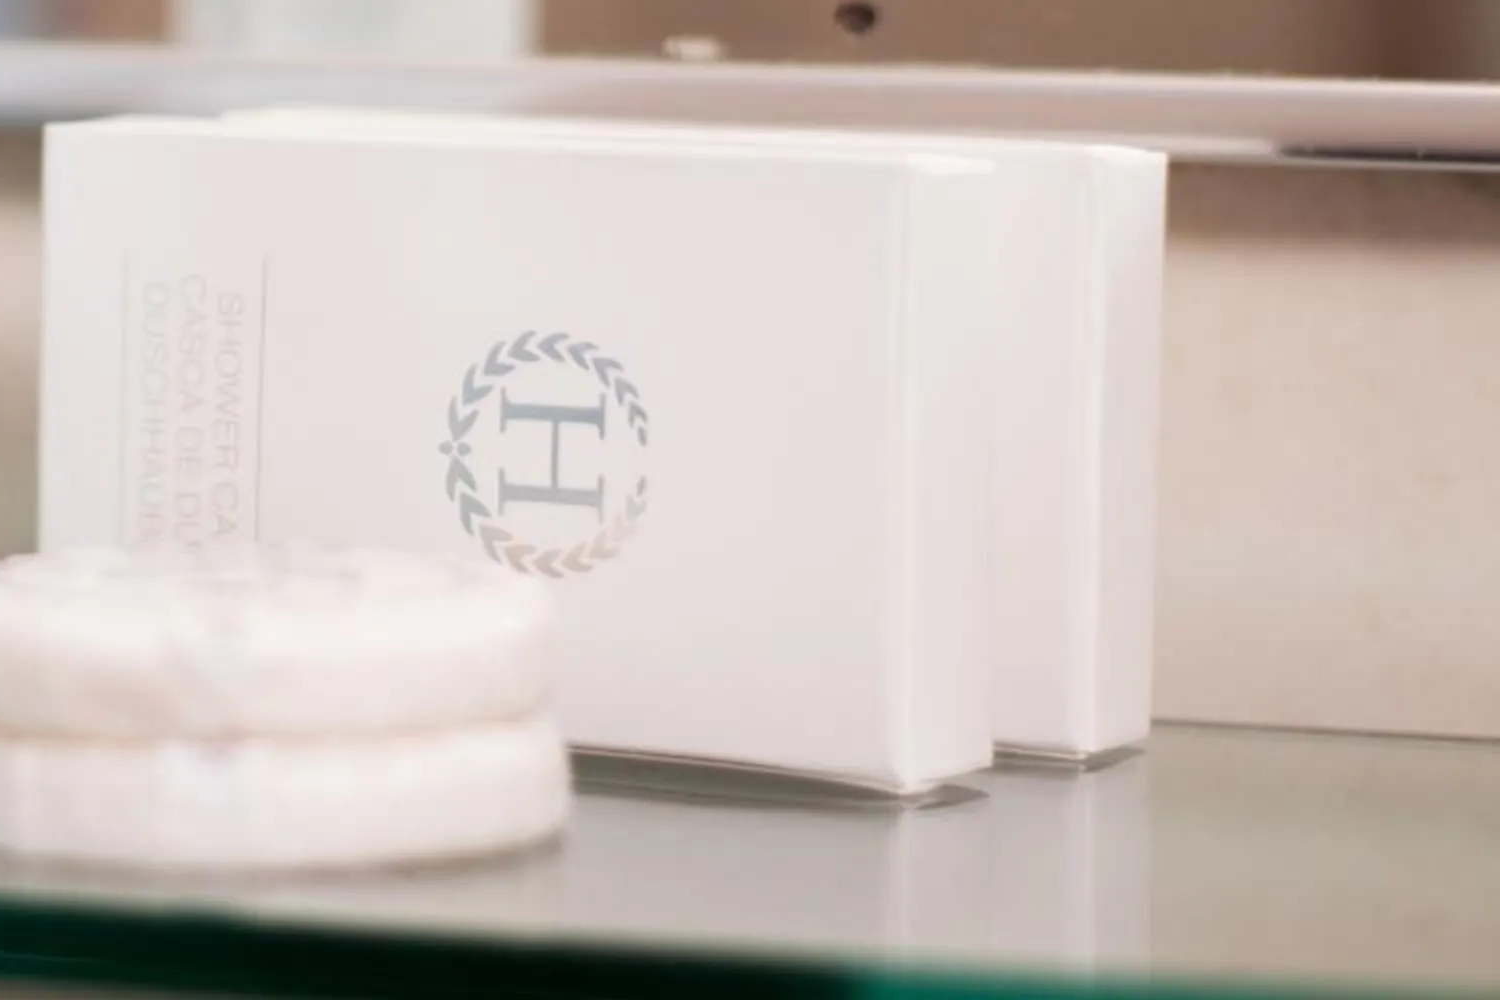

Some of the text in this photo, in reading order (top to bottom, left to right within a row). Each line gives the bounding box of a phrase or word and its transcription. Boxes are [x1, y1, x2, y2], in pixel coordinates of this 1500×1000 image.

[136, 281, 169, 542] DUSCHHAUB
[172, 272, 207, 551] CASCA DE DU
[210, 291, 245, 541] SHOWER CA
[498, 386, 604, 522] H
